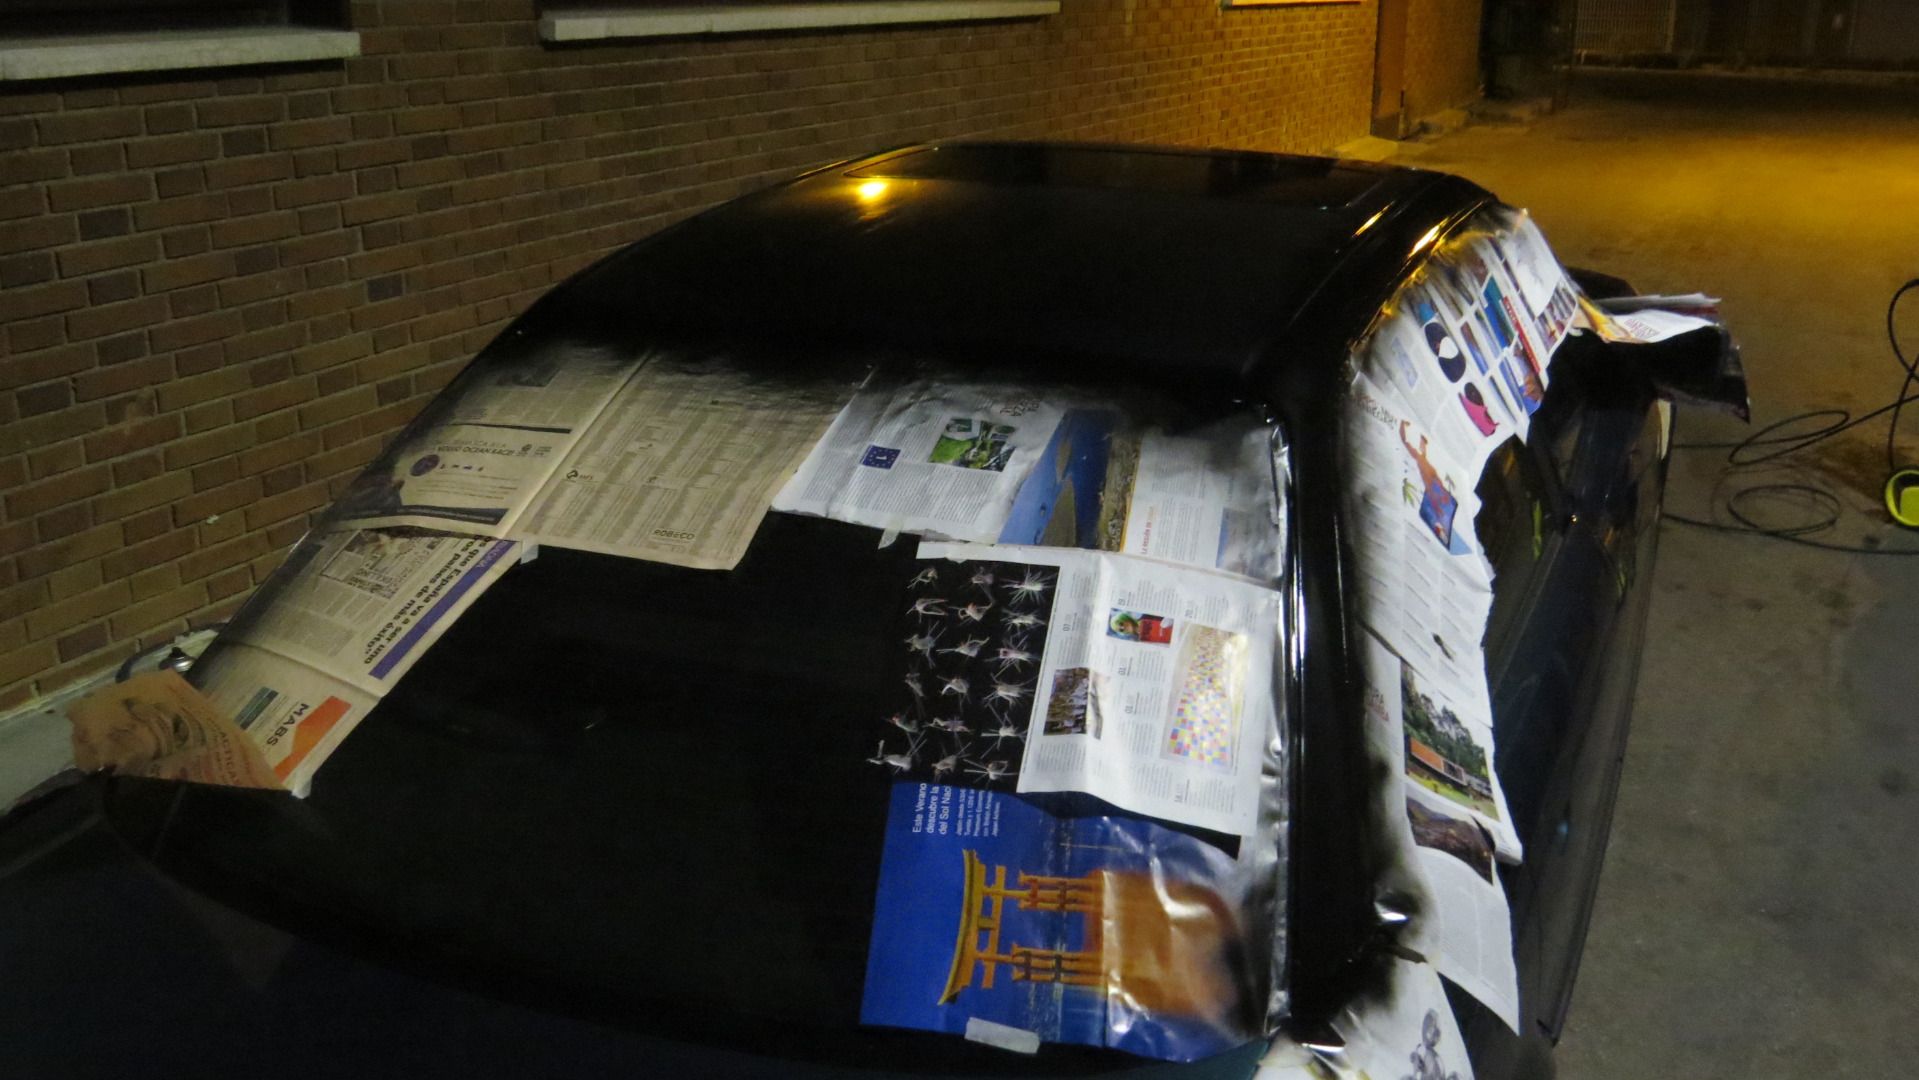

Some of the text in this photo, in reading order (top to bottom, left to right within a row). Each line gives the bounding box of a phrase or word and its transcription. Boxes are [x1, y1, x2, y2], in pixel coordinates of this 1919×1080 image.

[460, 549, 480, 567] que
[427, 553, 462, 585] países
[415, 584, 431, 599] de
[422, 568, 462, 604] España
[393, 599, 417, 621] más
[409, 604, 425, 617] va
[402, 618, 411, 626] a
[385, 626, 403, 644] ser
[364, 643, 386, 665] uno
[266, 702, 310, 746] MABS
[912, 782, 928, 833] Este Verano
[926, 785, 940, 833] descubre la
[940, 805, 950, 819] Sol
[939, 820, 948, 835] del
